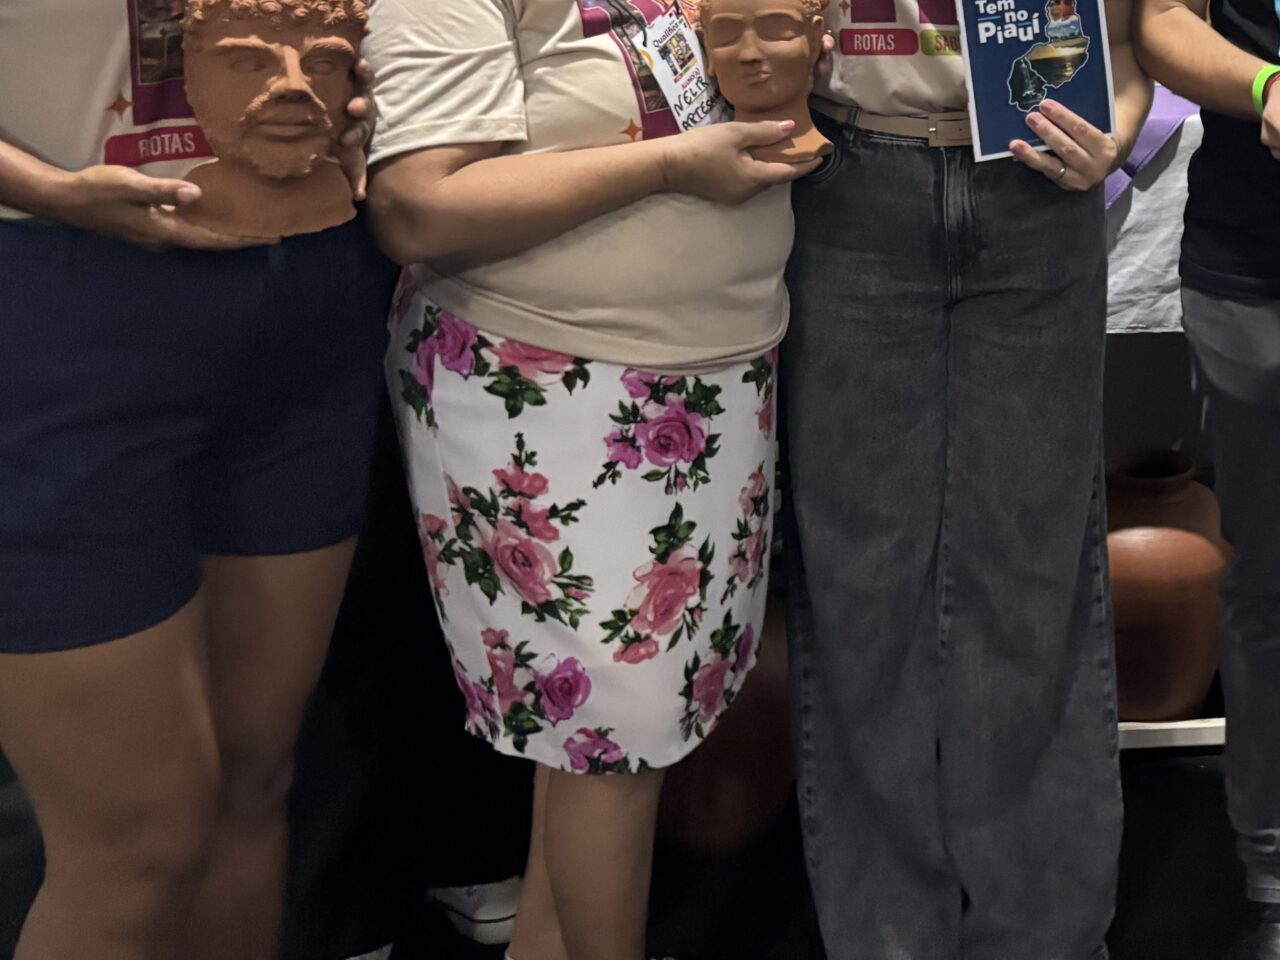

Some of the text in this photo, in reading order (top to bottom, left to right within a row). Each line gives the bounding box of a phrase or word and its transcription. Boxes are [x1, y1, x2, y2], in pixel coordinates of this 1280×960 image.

[1004, 10, 1028, 23] no
[978, 12, 1040, 44] Piauí
[854, 34, 896, 51] ROTAS
[138, 132, 196, 157] ROTAS
